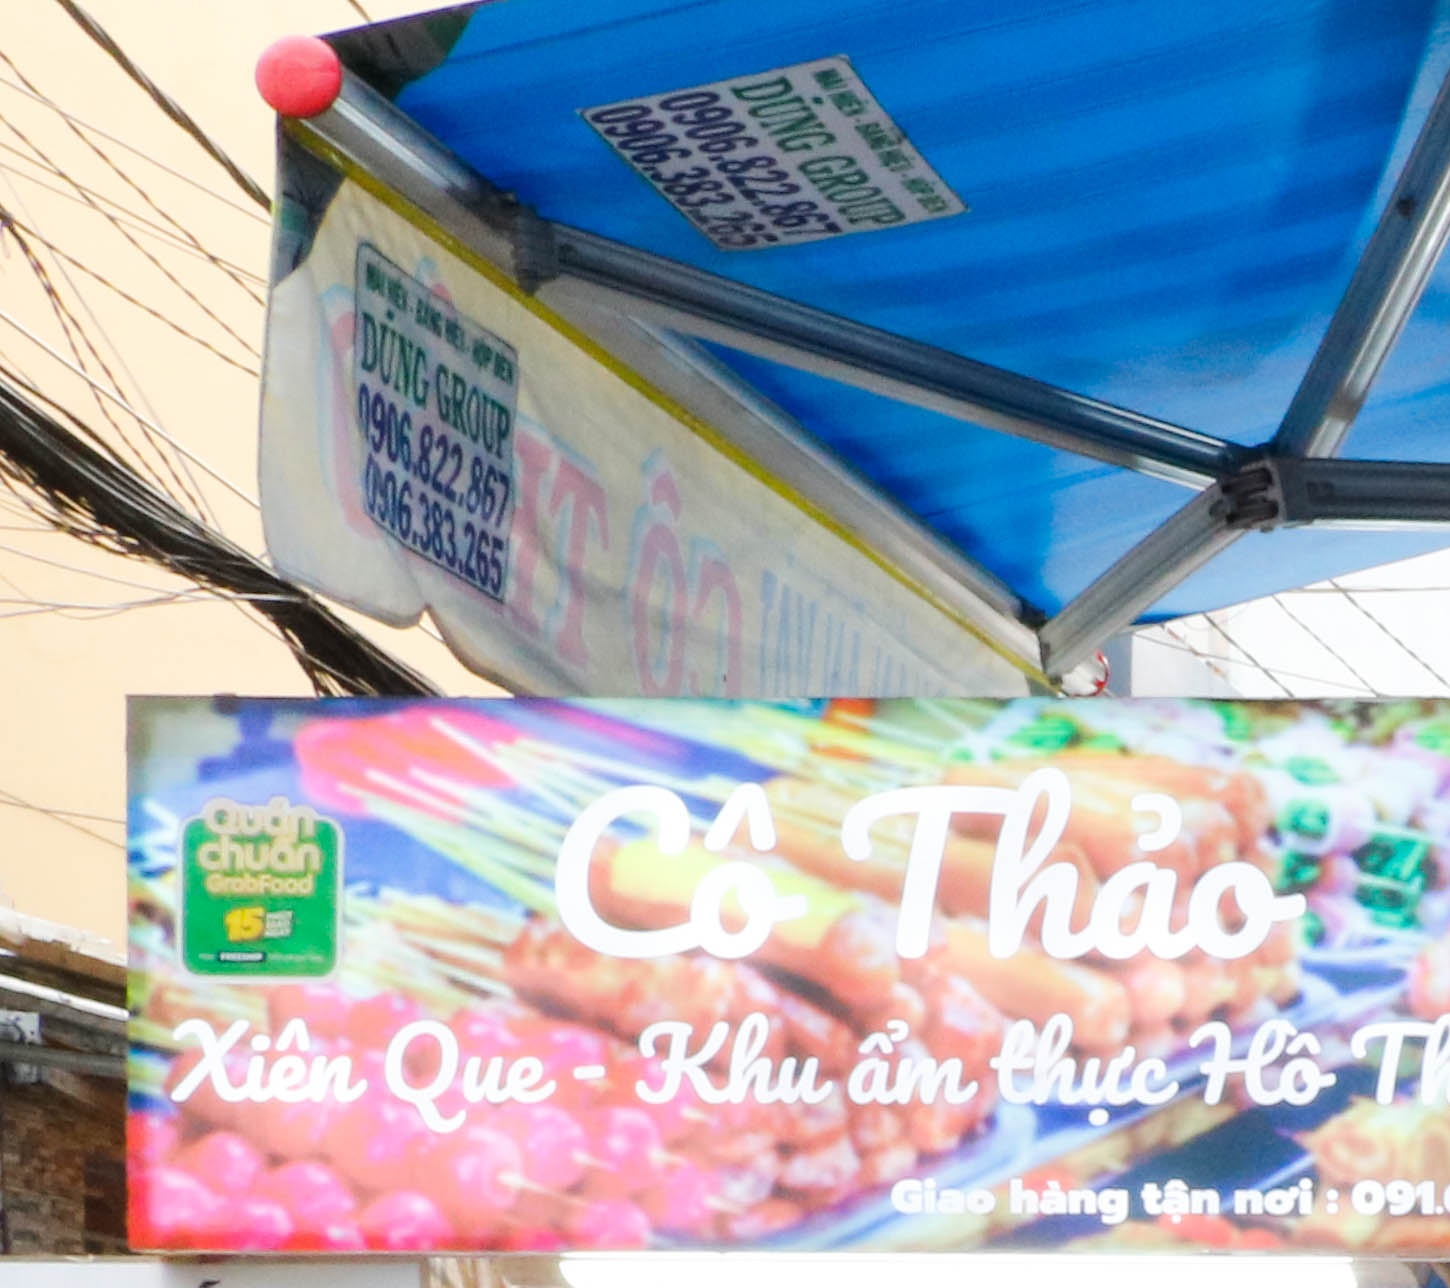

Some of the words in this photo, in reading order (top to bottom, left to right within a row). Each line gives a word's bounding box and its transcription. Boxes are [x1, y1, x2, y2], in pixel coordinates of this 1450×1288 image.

[658, 89, 844, 237] 0906.822.867
[799, 153, 906, 227] GROUP
[434, 362, 512, 461] GROUP
[204, 872, 316, 898] GrabFood
[555, 780, 806, 960] Cô
[842, 767, 1306, 963] Thảo
[224, 906, 266, 943] 15
[170, 1016, 367, 1104] Xiên
[383, 1018, 557, 1133] Que
[636, 1010, 831, 1104] Khu
[848, 1022, 977, 1104] ẩm
[992, 1012, 1178, 1125] thực
[1181, 1018, 1336, 1106] Hồ
[891, 1179, 995, 1215] Giao
[1010, 1176, 1129, 1224] hàng
[1141, 1179, 1220, 1224] tận
[1234, 1179, 1314, 1215] nơi
